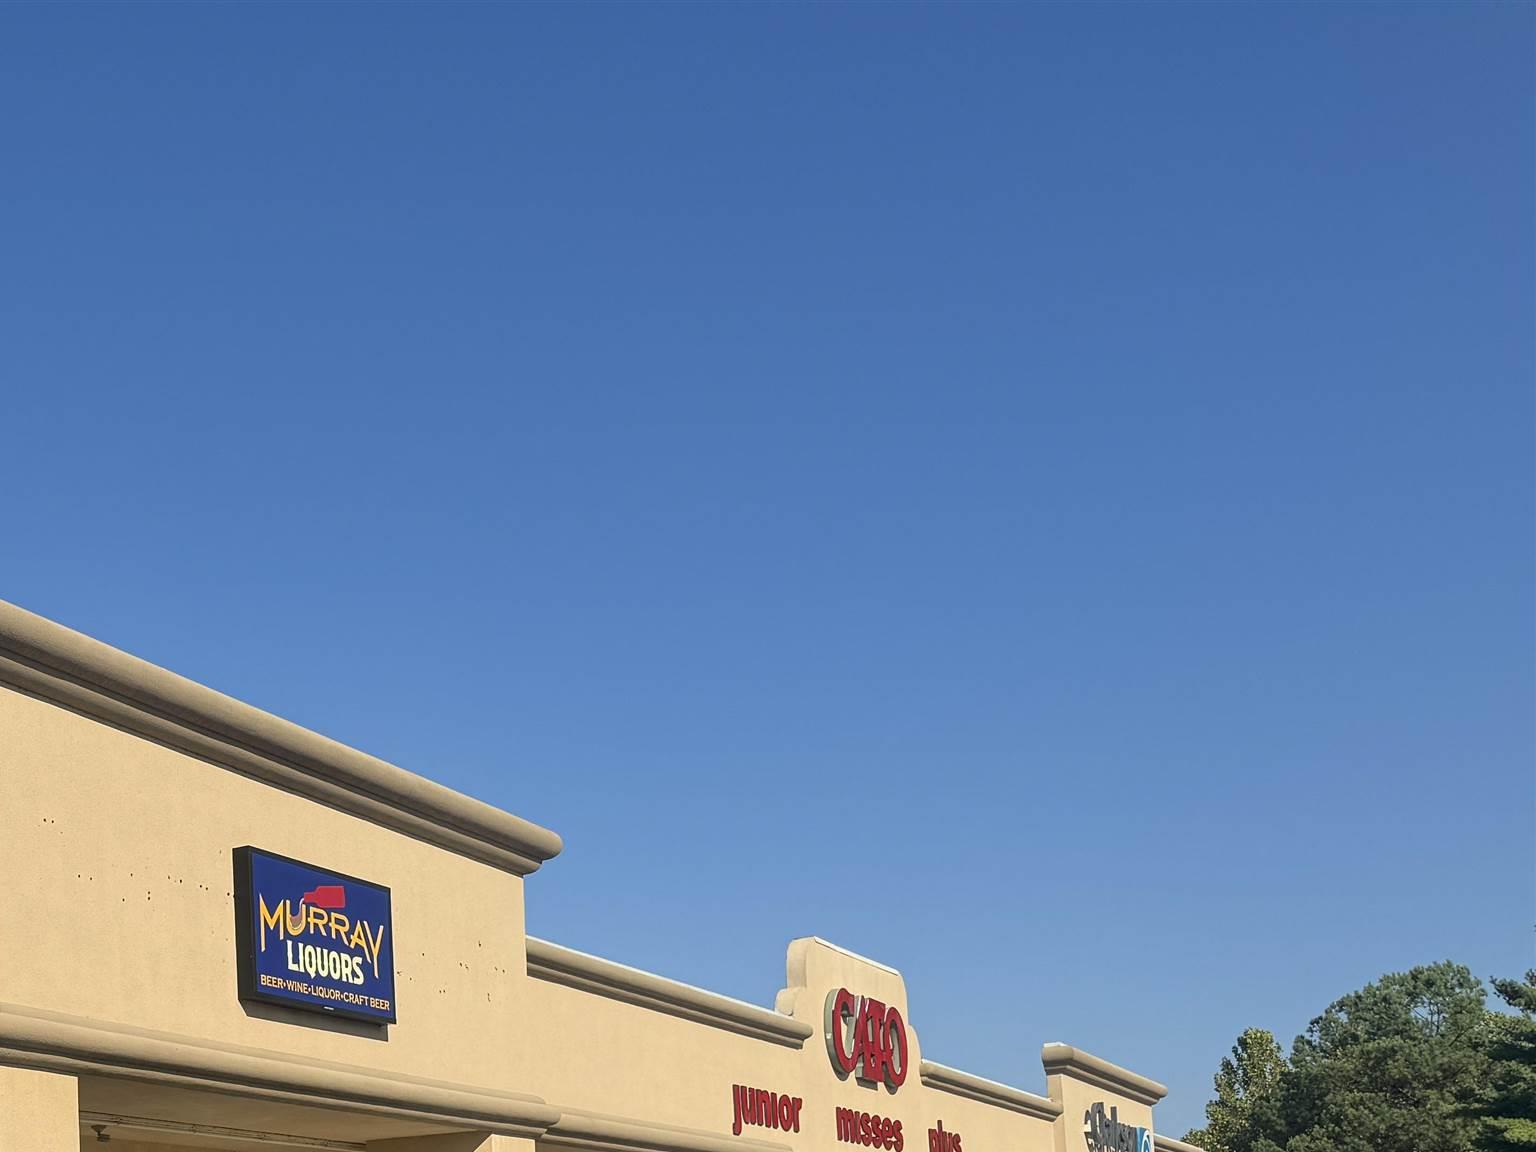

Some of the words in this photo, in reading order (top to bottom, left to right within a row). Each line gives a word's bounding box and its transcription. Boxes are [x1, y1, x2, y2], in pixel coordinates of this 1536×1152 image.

[259, 893, 384, 979] MURRAY
[286, 940, 363, 985] LIQUORS
[369, 997, 390, 1010] BEER
[826, 987, 908, 1092] CATO
[835, 1106, 904, 1152] misses
